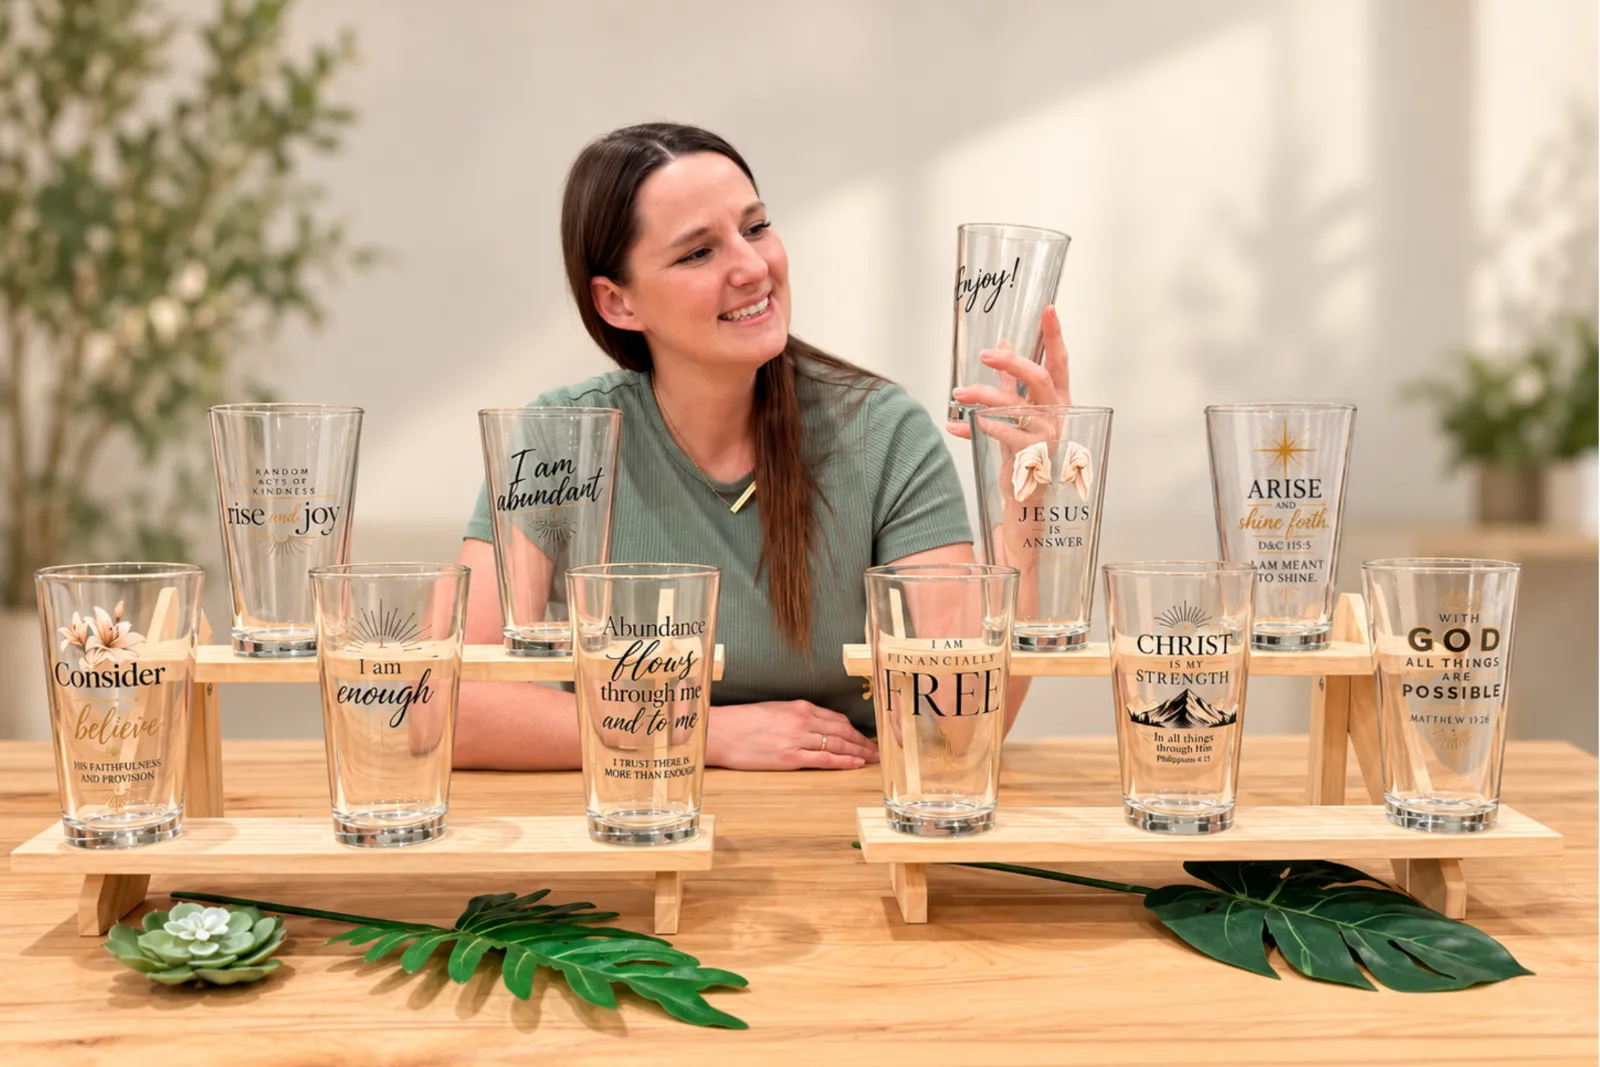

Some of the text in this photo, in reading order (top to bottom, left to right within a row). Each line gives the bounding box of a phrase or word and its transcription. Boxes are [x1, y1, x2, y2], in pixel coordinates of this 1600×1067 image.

[956, 257, 1020, 313] Enjoy!
[255, 468, 309, 476] RANDOM
[509, 448, 577, 485] I am
[252, 487, 316, 496] KINDNESS
[497, 467, 605, 512] abundant
[1247, 478, 1322, 499] ARISE
[1275, 501, 1296, 509] AND
[227, 501, 340, 536] rise and joy
[1018, 505, 1089, 523] JESUS
[1238, 507, 1284, 530] shine
[1049, 525, 1061, 535] IS
[1022, 536, 1083, 548] ANSWER
[1258, 541, 1312, 550] D&C 115:5
[1259, 560, 1278, 570] AM
[1282, 560, 1325, 570] MEANT
[1258, 572, 1318, 583] TO SHINE.
[1439, 613, 1480, 624] WITH
[603, 615, 706, 637] Abundance
[931, 640, 964, 649] I AM
[1136, 633, 1233, 656] CHRIST
[1407, 627, 1501, 653] GOD
[360, 658, 402, 675] I am
[605, 639, 700, 682] flows
[887, 653, 996, 667] FINANCIALLY
[1169, 660, 1204, 669] IS MY
[1405, 657, 1500, 669] ALL THINGS
[54, 661, 166, 689] Consider
[1136, 669, 1229, 686] STRENGTH
[1442, 672, 1471, 682] ARE
[337, 668, 435, 729] enough
[601, 681, 702, 708] through me
[885, 667, 1002, 718] FREE
[1402, 683, 1501, 700] POSSIBLE
[75, 703, 162, 745] believe
[602, 707, 699, 736] and to me
[1409, 714, 1465, 725] MATTHEW
[1154, 732, 1214, 744] In all things
[1156, 744, 1193, 755] through
[74, 758, 162, 772] HIS FAITHFULNESS
[619, 758, 650, 769] TRUST
[652, 756, 683, 768] THERE
[80, 772, 155, 784] AND PROVISION
[604, 768, 632, 779] MORE
[634, 771, 662, 780] THAN
